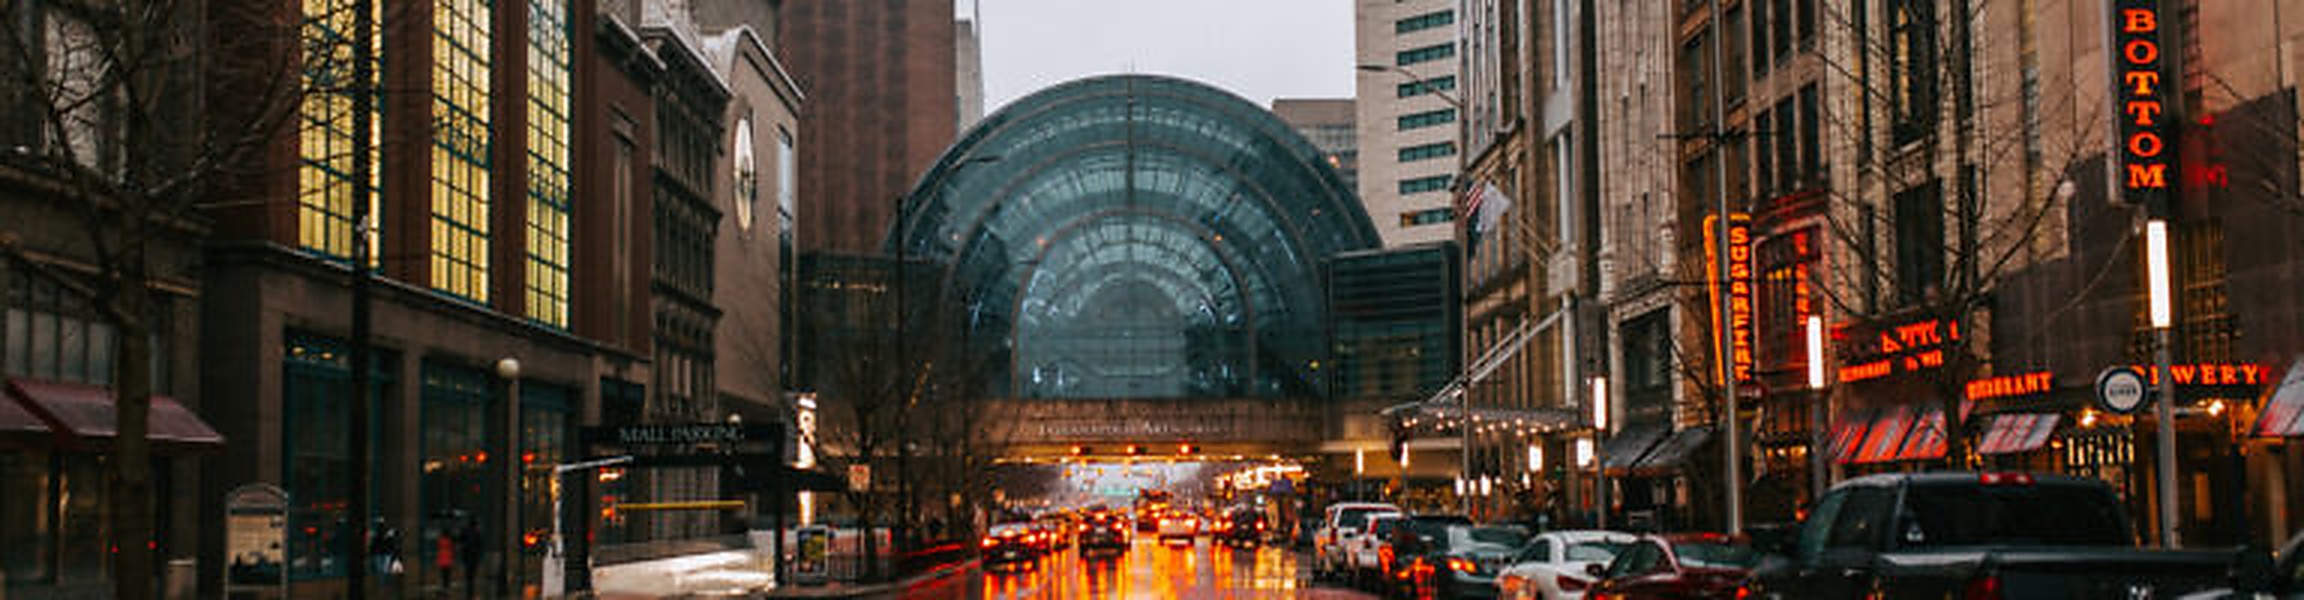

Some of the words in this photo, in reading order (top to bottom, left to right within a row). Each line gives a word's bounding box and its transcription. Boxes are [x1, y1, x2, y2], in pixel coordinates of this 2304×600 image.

[2123, 8, 2167, 188] BOTTOM
[2129, 363, 2258, 385] WERY
[620, 427, 664, 442] MALL
